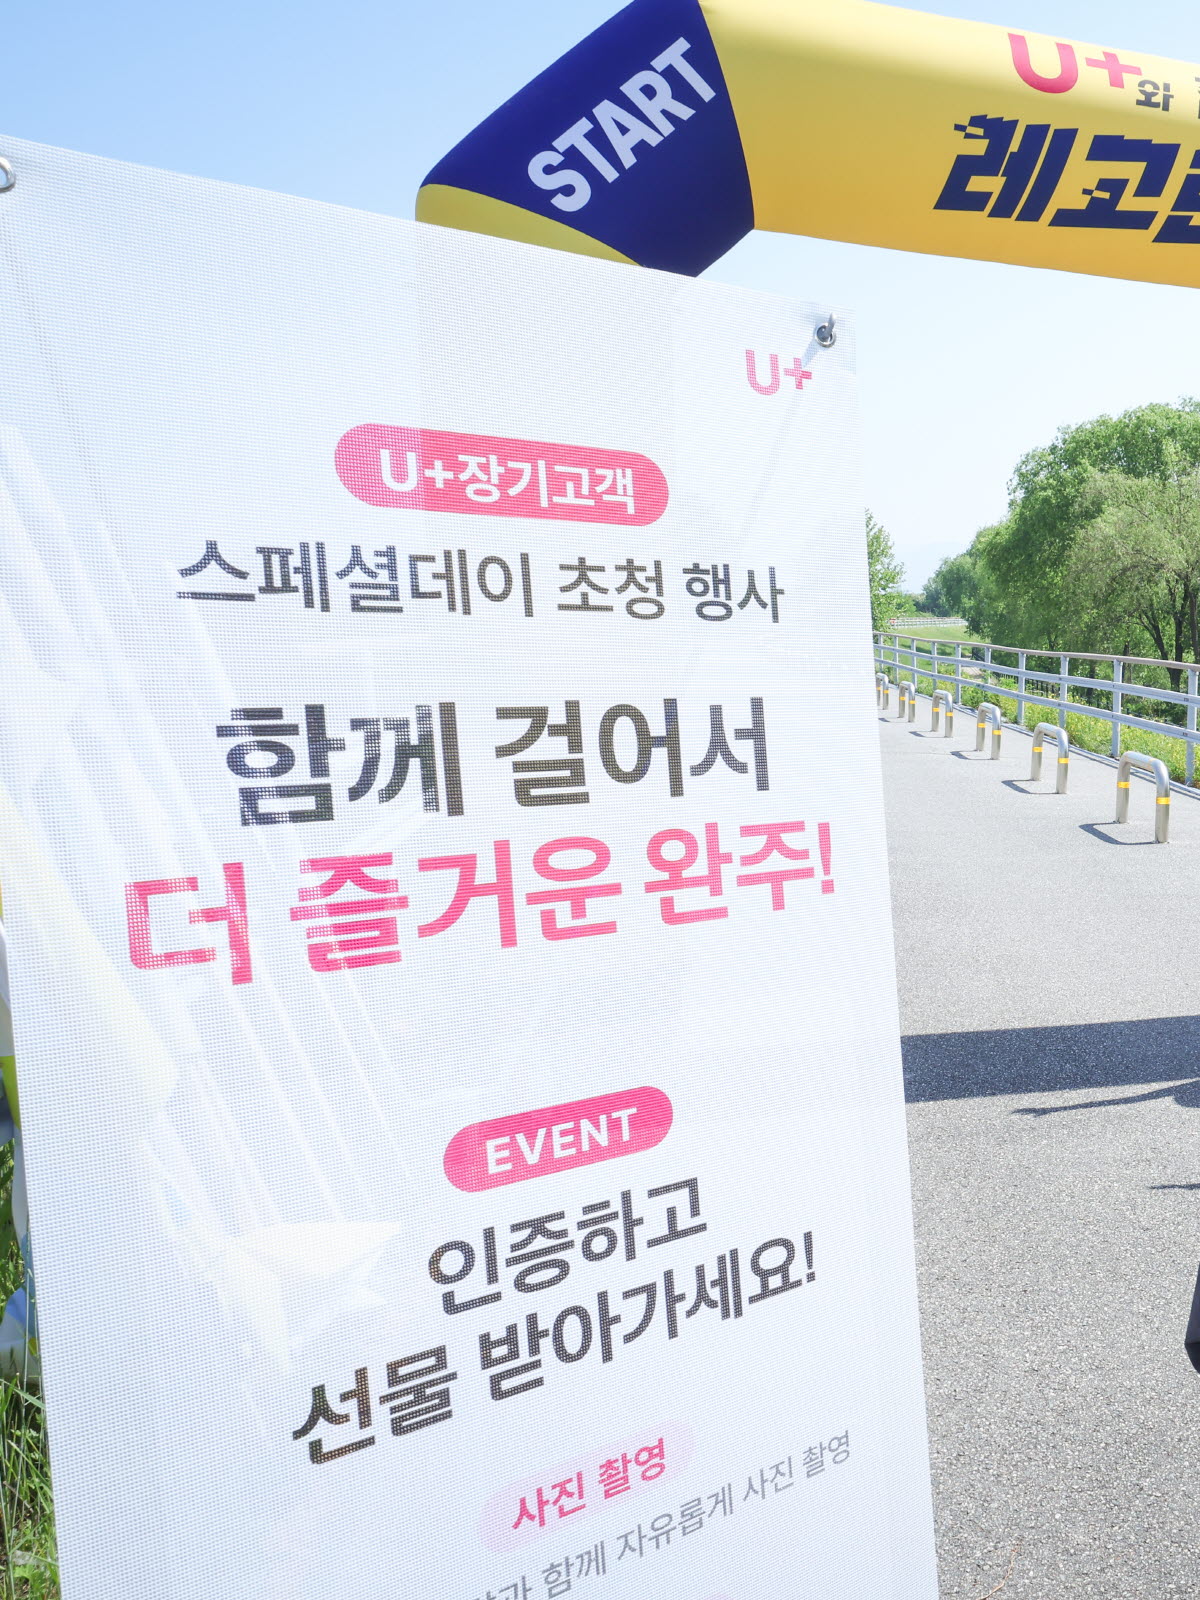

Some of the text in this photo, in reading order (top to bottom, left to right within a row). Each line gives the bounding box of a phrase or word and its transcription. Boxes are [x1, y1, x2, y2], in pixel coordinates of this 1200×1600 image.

[528, 36, 717, 213] START
[745, 349, 813, 396] U+
[380, 448, 636, 515] U+장기고객
[176, 539, 785, 624] 스페셜데이 초청 행사
[215, 696, 770, 826] 함께 걸어서
[124, 820, 835, 985] 더 즐거운 완주!
[485, 1106, 639, 1175] EVENT
[428, 1177, 708, 1316] 인증하고
[292, 1230, 816, 1465] 선물 받아가세요!
[511, 1437, 667, 1529] 사진 촬영
[541, 1540, 607, 1600] 함께
[616, 1482, 734, 1561] 자유롭게
[743, 1455, 794, 1502] 사진
[802, 1429, 851, 1478] 촬영
